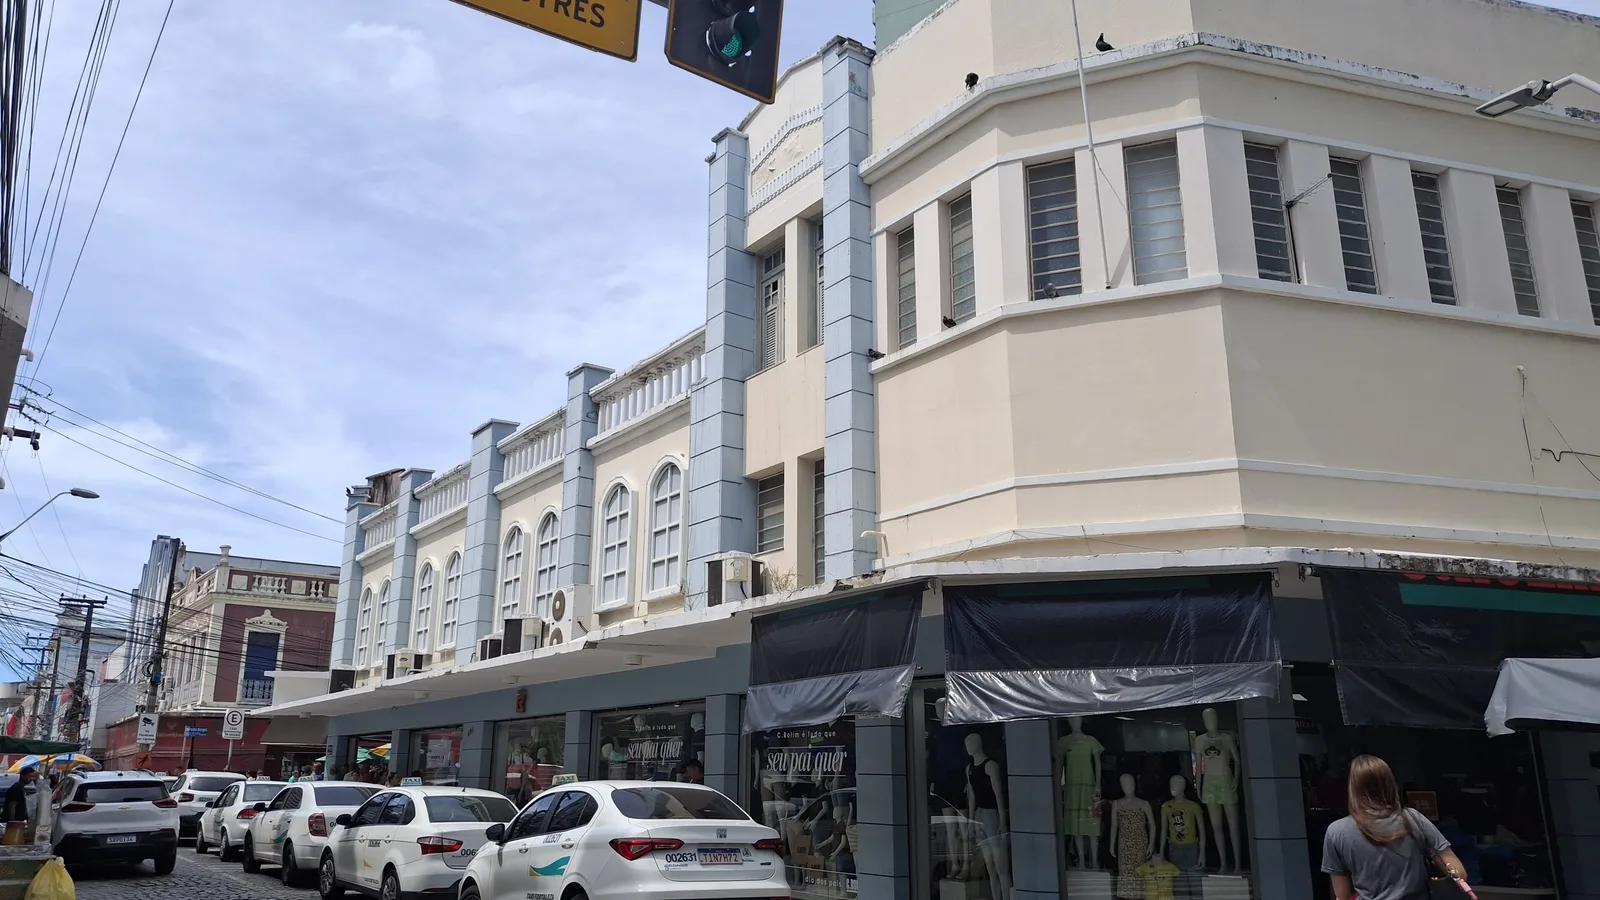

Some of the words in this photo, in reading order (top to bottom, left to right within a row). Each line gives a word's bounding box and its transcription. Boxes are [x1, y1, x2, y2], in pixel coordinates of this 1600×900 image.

[521, 0, 606, 28] RES
[231, 714, 237, 722] E
[808, 730, 822, 738] tudo
[627, 742, 641, 759] seu
[660, 741, 683, 765] quer
[766, 752, 787, 772] seu
[787, 751, 812, 780] pai
[814, 751, 848, 780] quer
[665, 852, 697, 863] 002631
[703, 853, 739, 863] TIN7H72
[805, 876, 815, 884] dia
[816, 877, 827, 885] dos
[828, 879, 842, 887] pais
